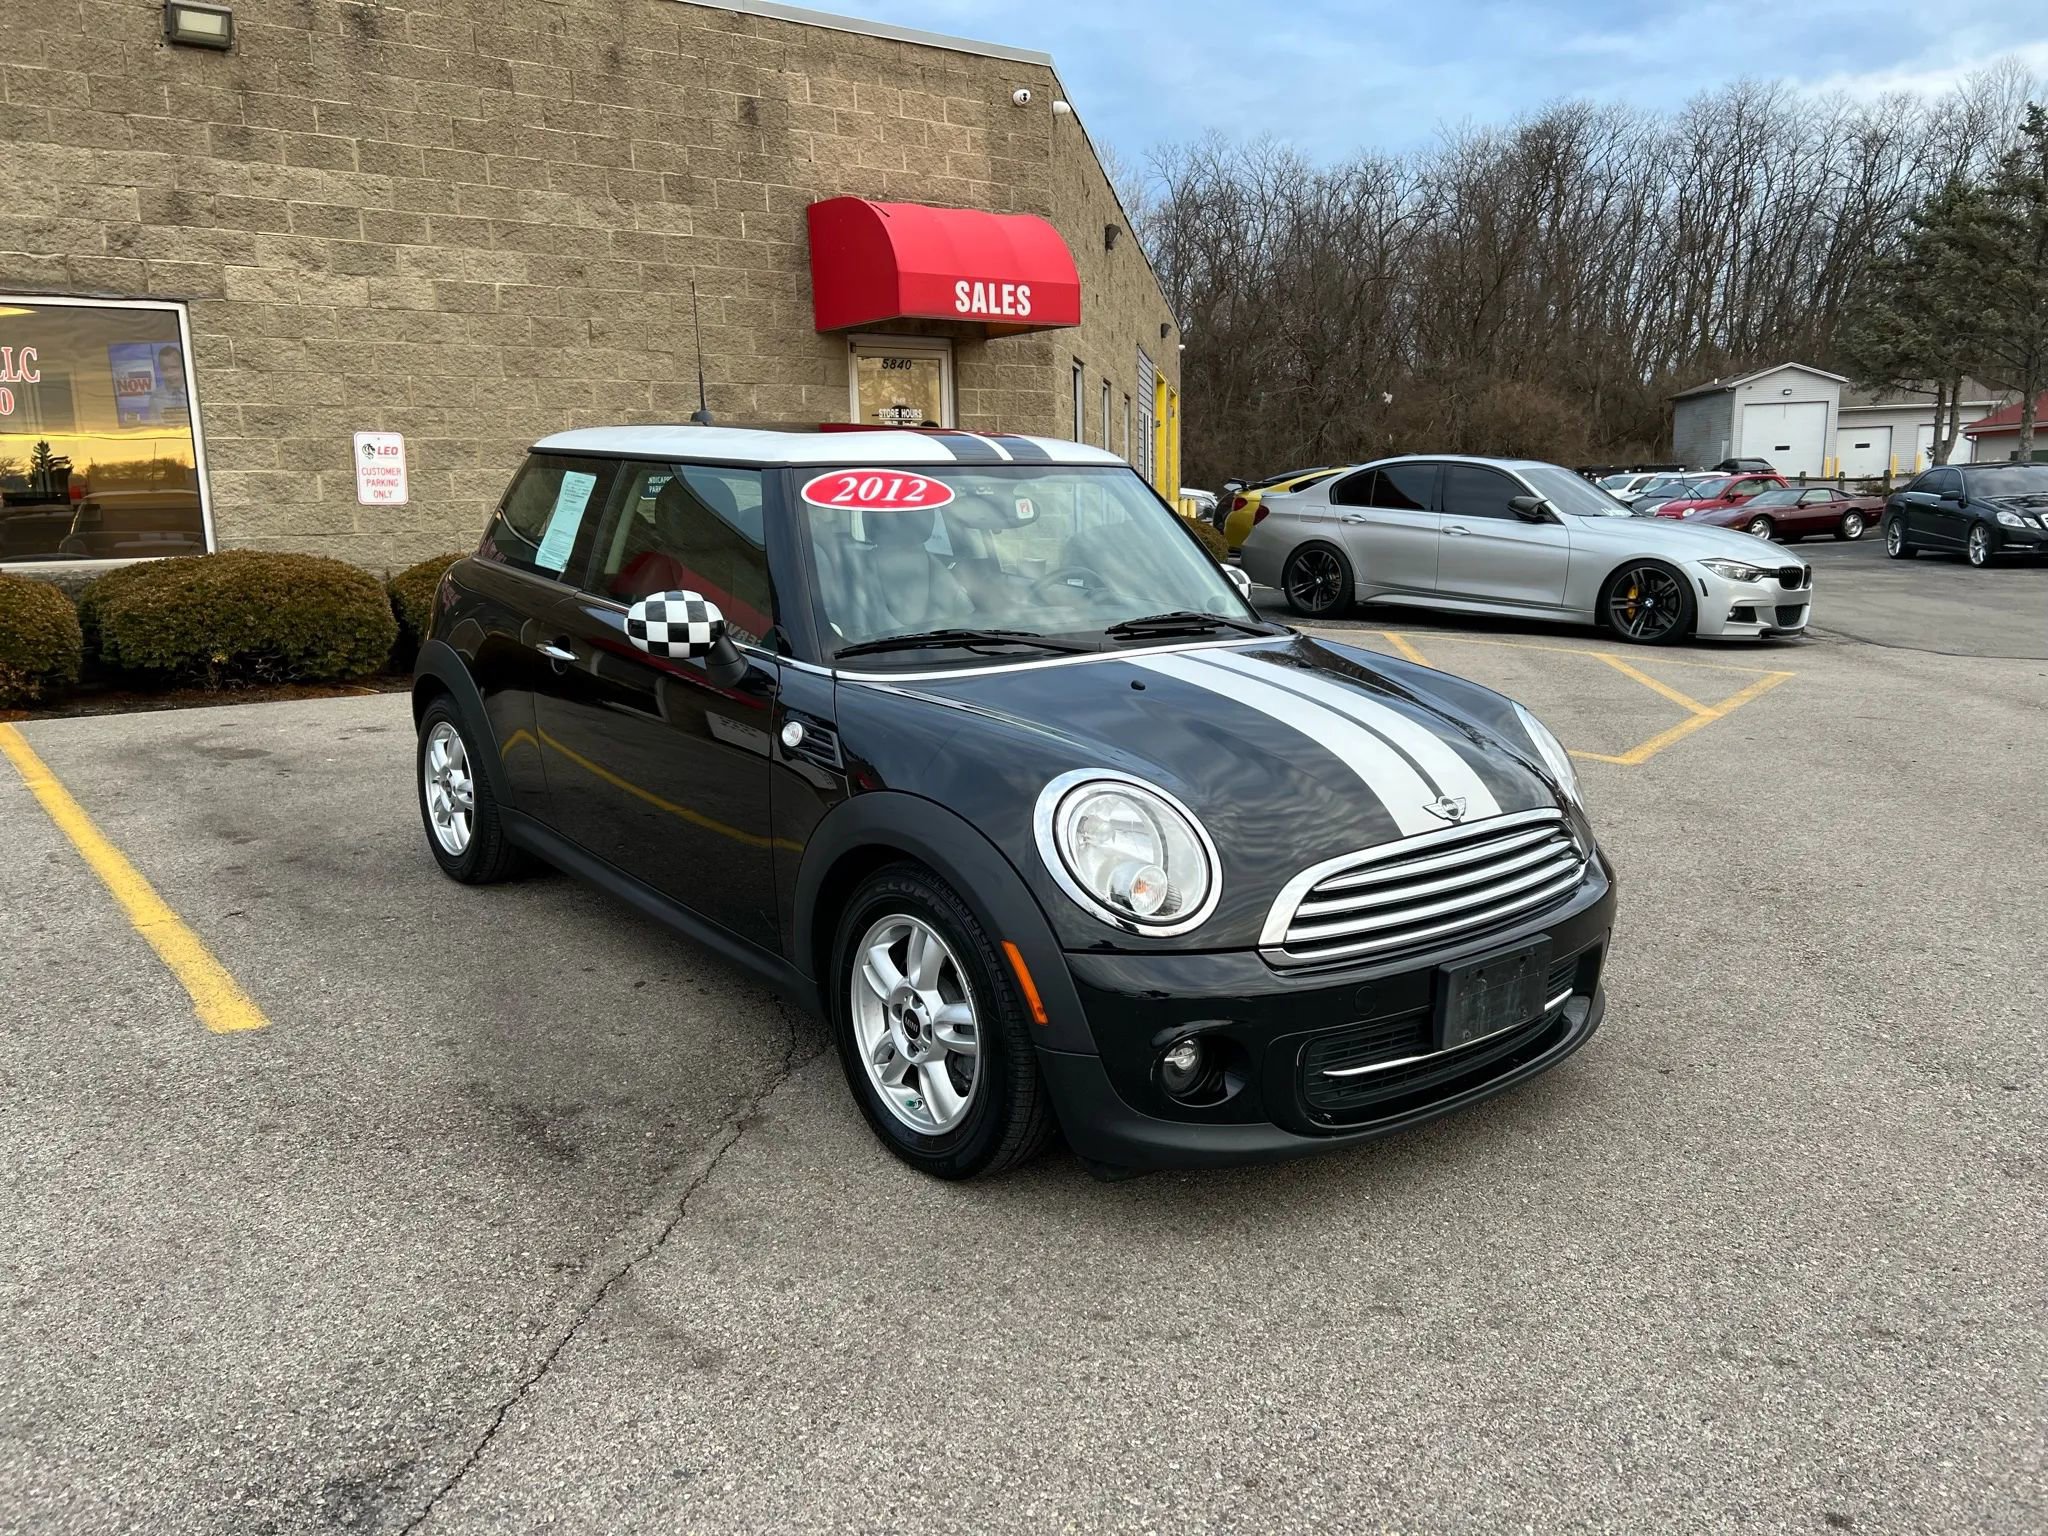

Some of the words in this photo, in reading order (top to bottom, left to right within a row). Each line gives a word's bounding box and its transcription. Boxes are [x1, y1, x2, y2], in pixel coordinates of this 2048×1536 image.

[955, 280, 1032, 317] SALES
[882, 358, 912, 370] 5840
[116, 378, 152, 393] NOW
[879, 408, 900, 418] STORE
[901, 408, 923, 419] HOURS
[377, 446, 399, 456] LEO
[361, 467, 402, 476] CUSTOMER
[366, 479, 399, 488] PARKING
[373, 490, 393, 499] ONLY
[831, 476, 928, 503] 2012
